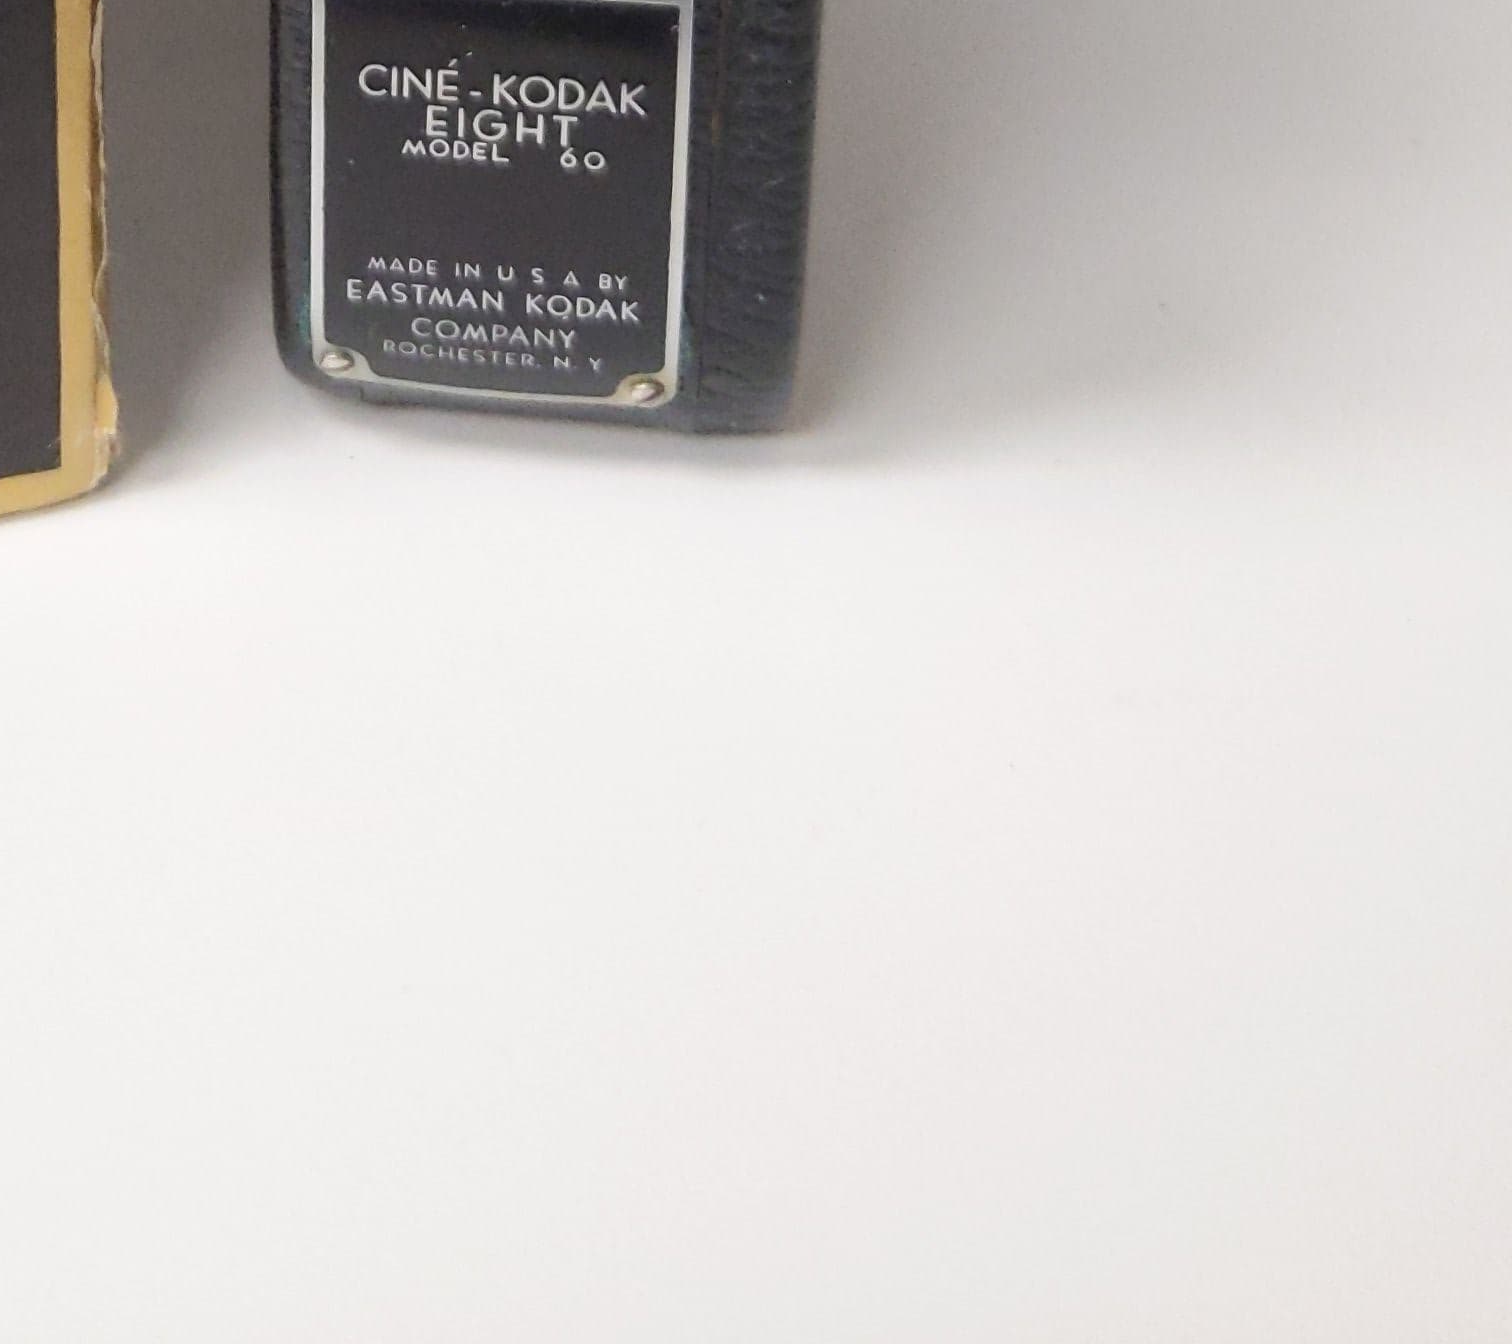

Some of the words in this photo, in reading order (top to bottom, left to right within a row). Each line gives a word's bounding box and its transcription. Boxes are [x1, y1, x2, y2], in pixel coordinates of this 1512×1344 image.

[425, 104, 580, 147] EIGHT
[401, 138, 510, 164] MODEL
[559, 147, 606, 170] 60
[368, 256, 438, 276] MADE
[454, 262, 481, 278] IN
[598, 273, 628, 291] BY
[346, 278, 505, 312] EASTMAN
[525, 293, 640, 321] KODAK
[410, 316, 577, 349] COMPANY
